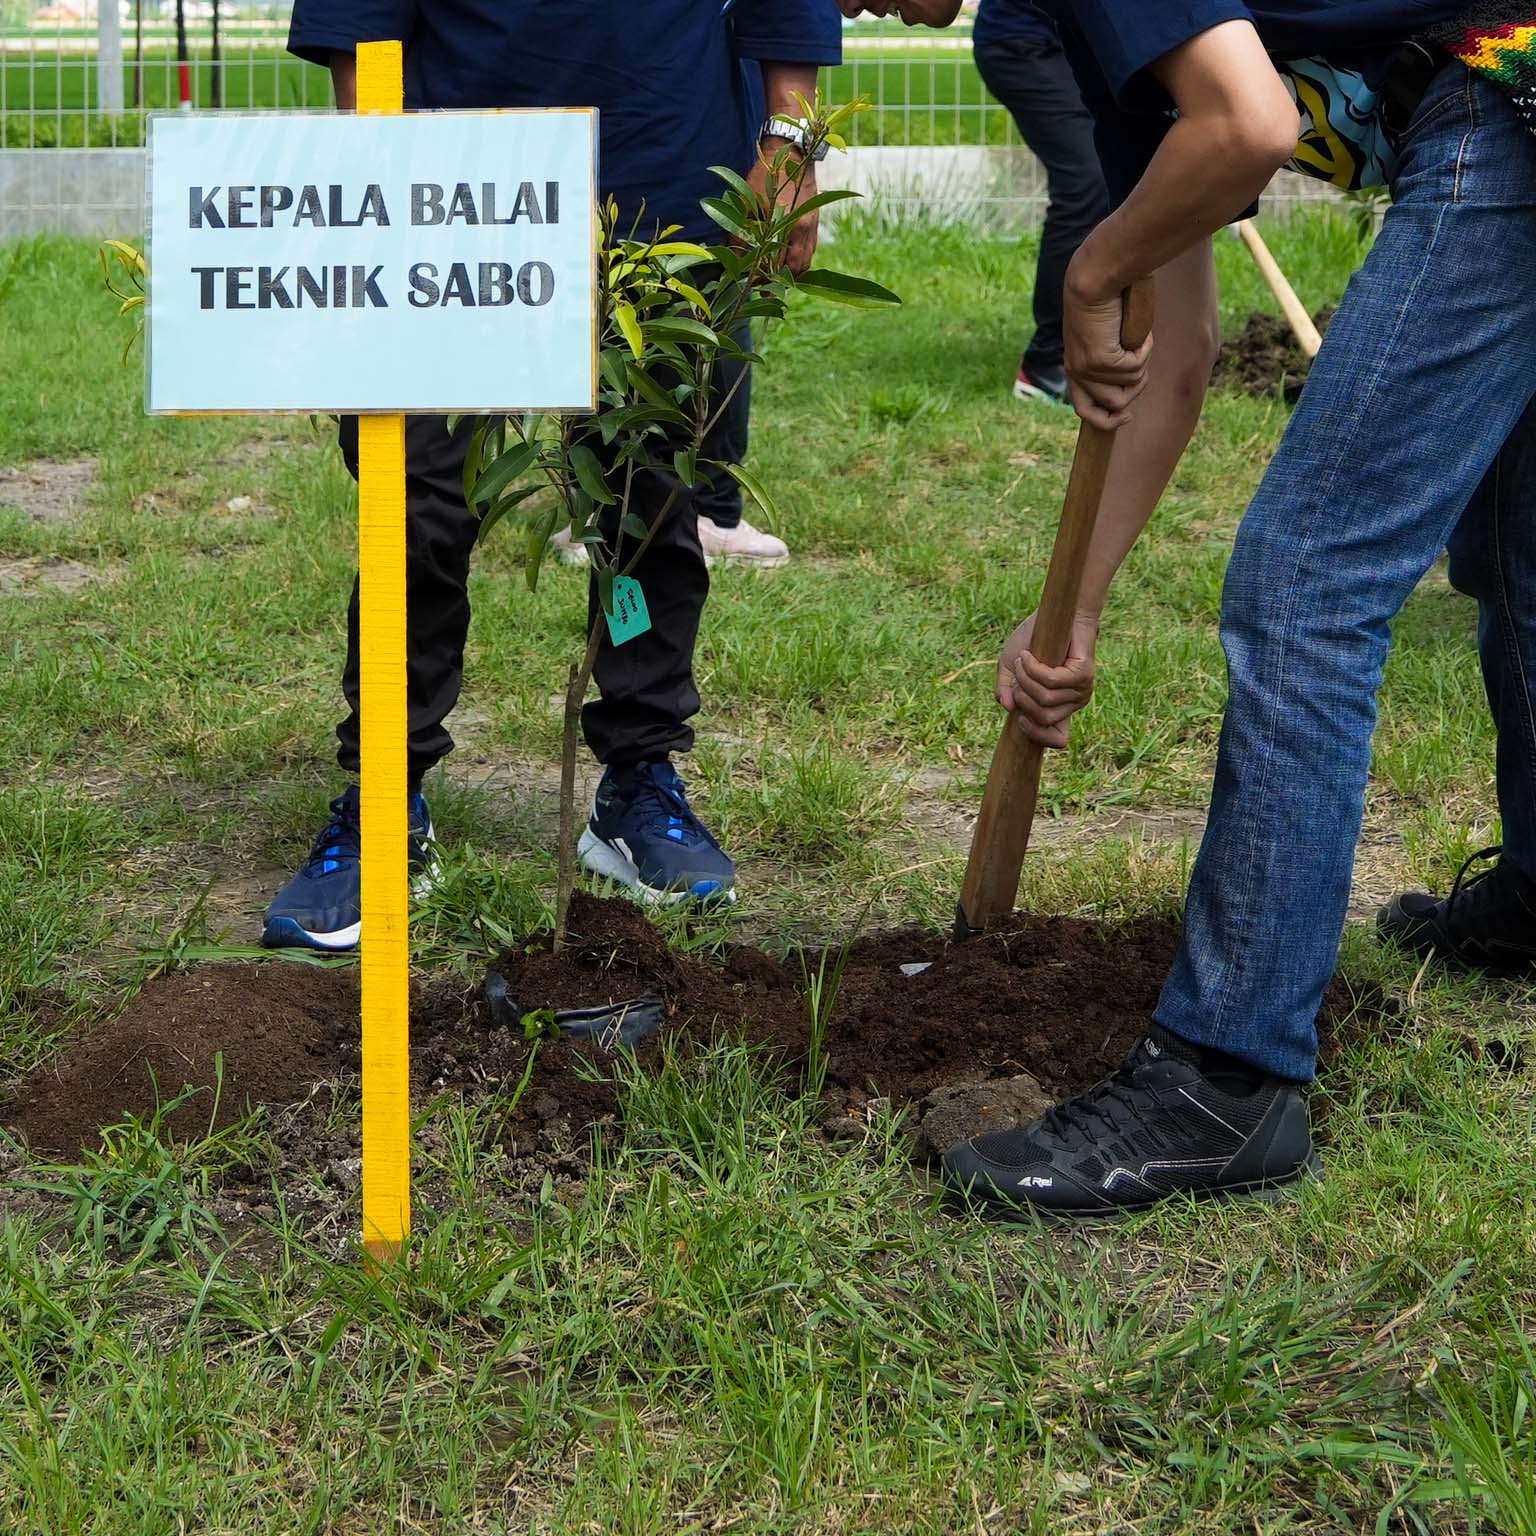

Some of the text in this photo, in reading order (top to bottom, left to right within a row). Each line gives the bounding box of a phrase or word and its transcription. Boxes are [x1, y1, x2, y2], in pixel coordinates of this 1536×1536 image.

[188, 181, 560, 229] KEPALA BALAI
[190, 261, 556, 310] TEKNIK SABO
